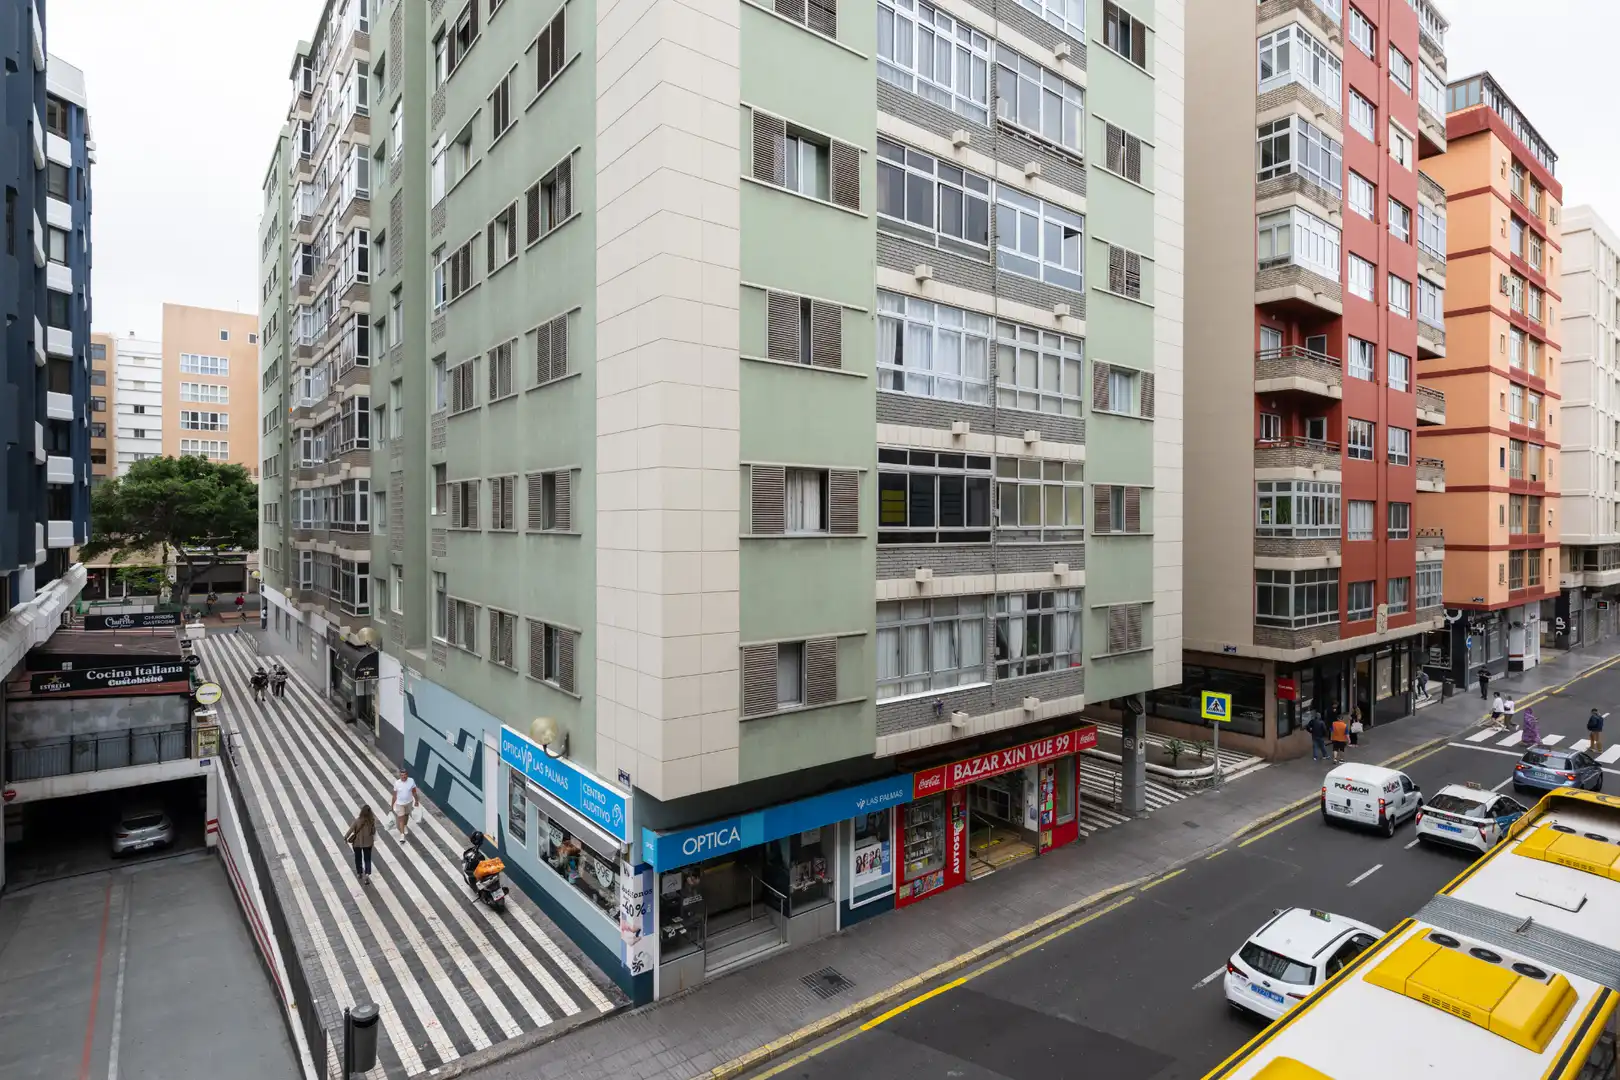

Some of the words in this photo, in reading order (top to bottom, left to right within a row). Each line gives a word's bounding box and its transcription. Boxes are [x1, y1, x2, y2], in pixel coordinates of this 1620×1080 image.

[86, 669, 132, 680] Cocina
[135, 665, 183, 676] Italiana
[502, 740, 521, 761] OPTICA
[532, 758, 544, 775] LAS
[544, 766, 569, 790] PALMAS
[953, 755, 999, 781] BAZAR
[1003, 746, 1026, 767] XIN
[1029, 740, 1053, 758] YUE
[1056, 734, 1070, 751] 99
[582, 783, 607, 805] CENTRO
[866, 795, 879, 806] LAS
[880, 789, 904, 802] PALMAS
[582, 799, 611, 823] AUDITIVO
[682, 826, 741, 856] OPTICA
